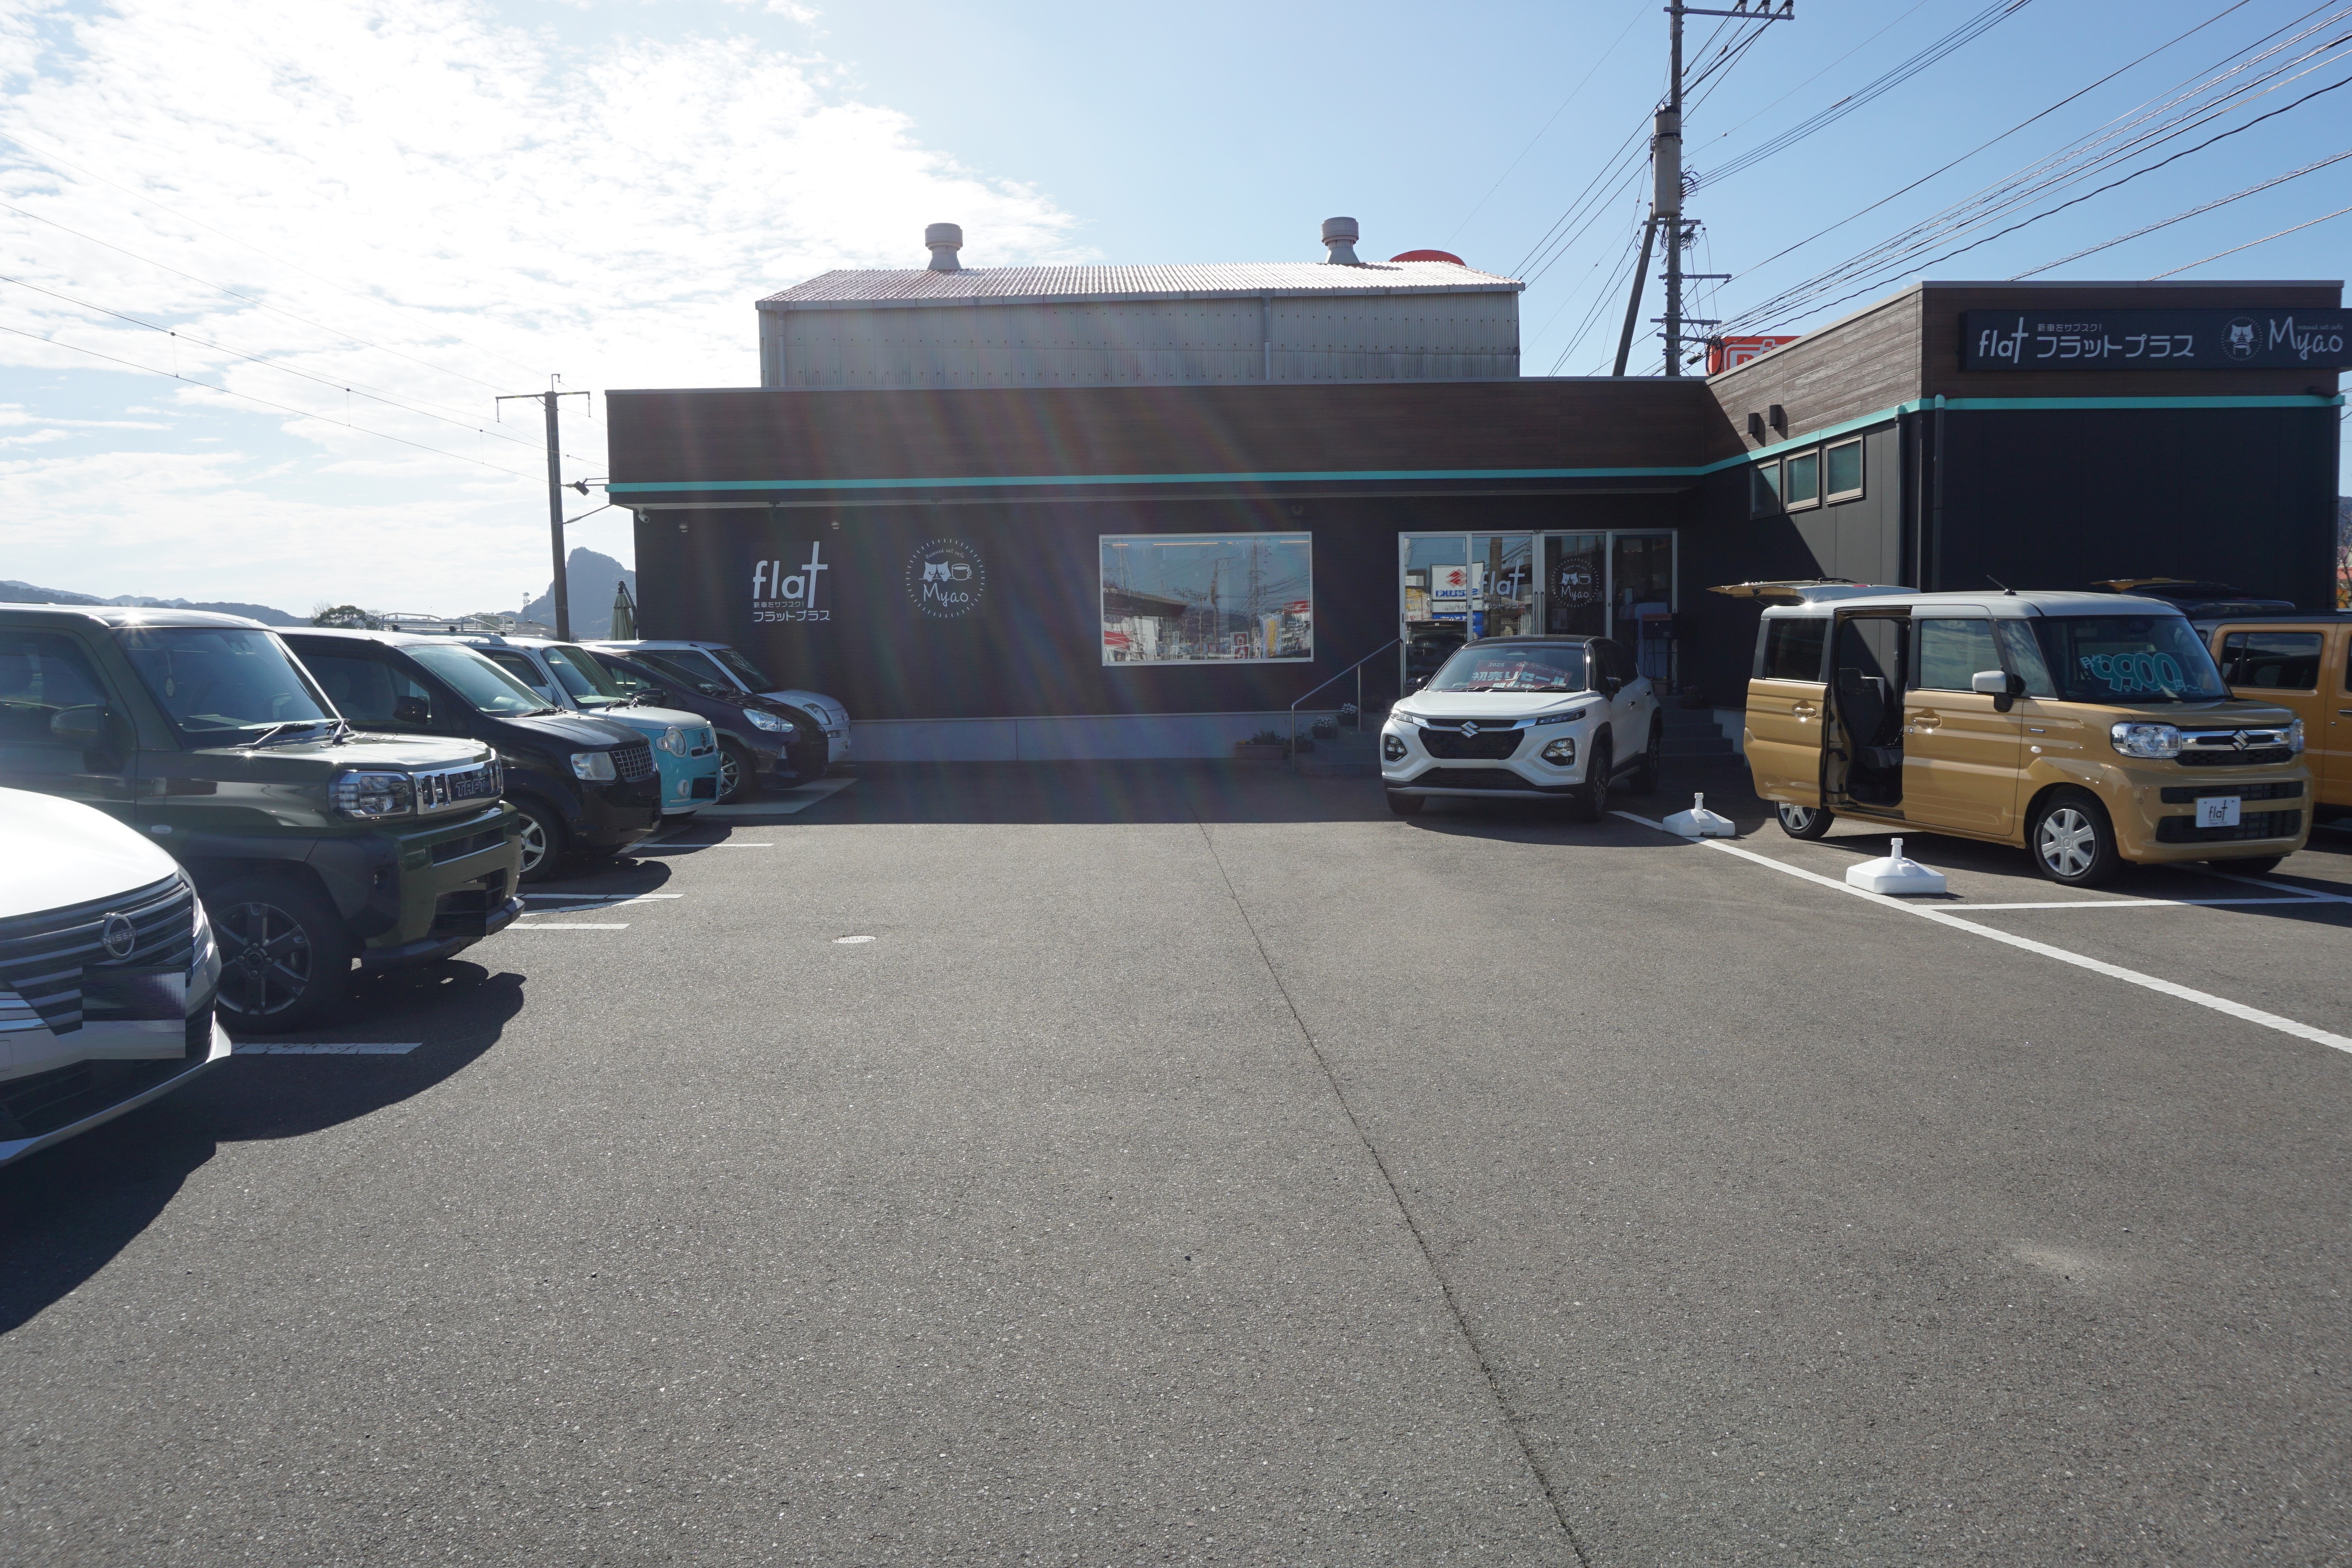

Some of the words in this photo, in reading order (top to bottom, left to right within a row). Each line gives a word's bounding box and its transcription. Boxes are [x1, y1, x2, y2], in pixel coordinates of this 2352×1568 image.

[2038, 323, 2102, 332] 新車をサブスク!
[1979, 317, 2029, 363] flat
[2037, 334, 2194, 358] フラットプラス
[2269, 316, 2343, 360] Myao
[925, 548, 944, 559] Rescued
[753, 541, 828, 608] flat
[1479, 559, 1525, 601] flat
[923, 582, 969, 607] Myao
[1561, 585, 1589, 601] Myao
[753, 610, 830, 622] フラットプラス
[1472, 671, 1566, 686] 初売りセール
[455, 777, 485, 797] TAFT
[2209, 800, 2228, 821] flat
[103, 930, 136, 944] NISSA
